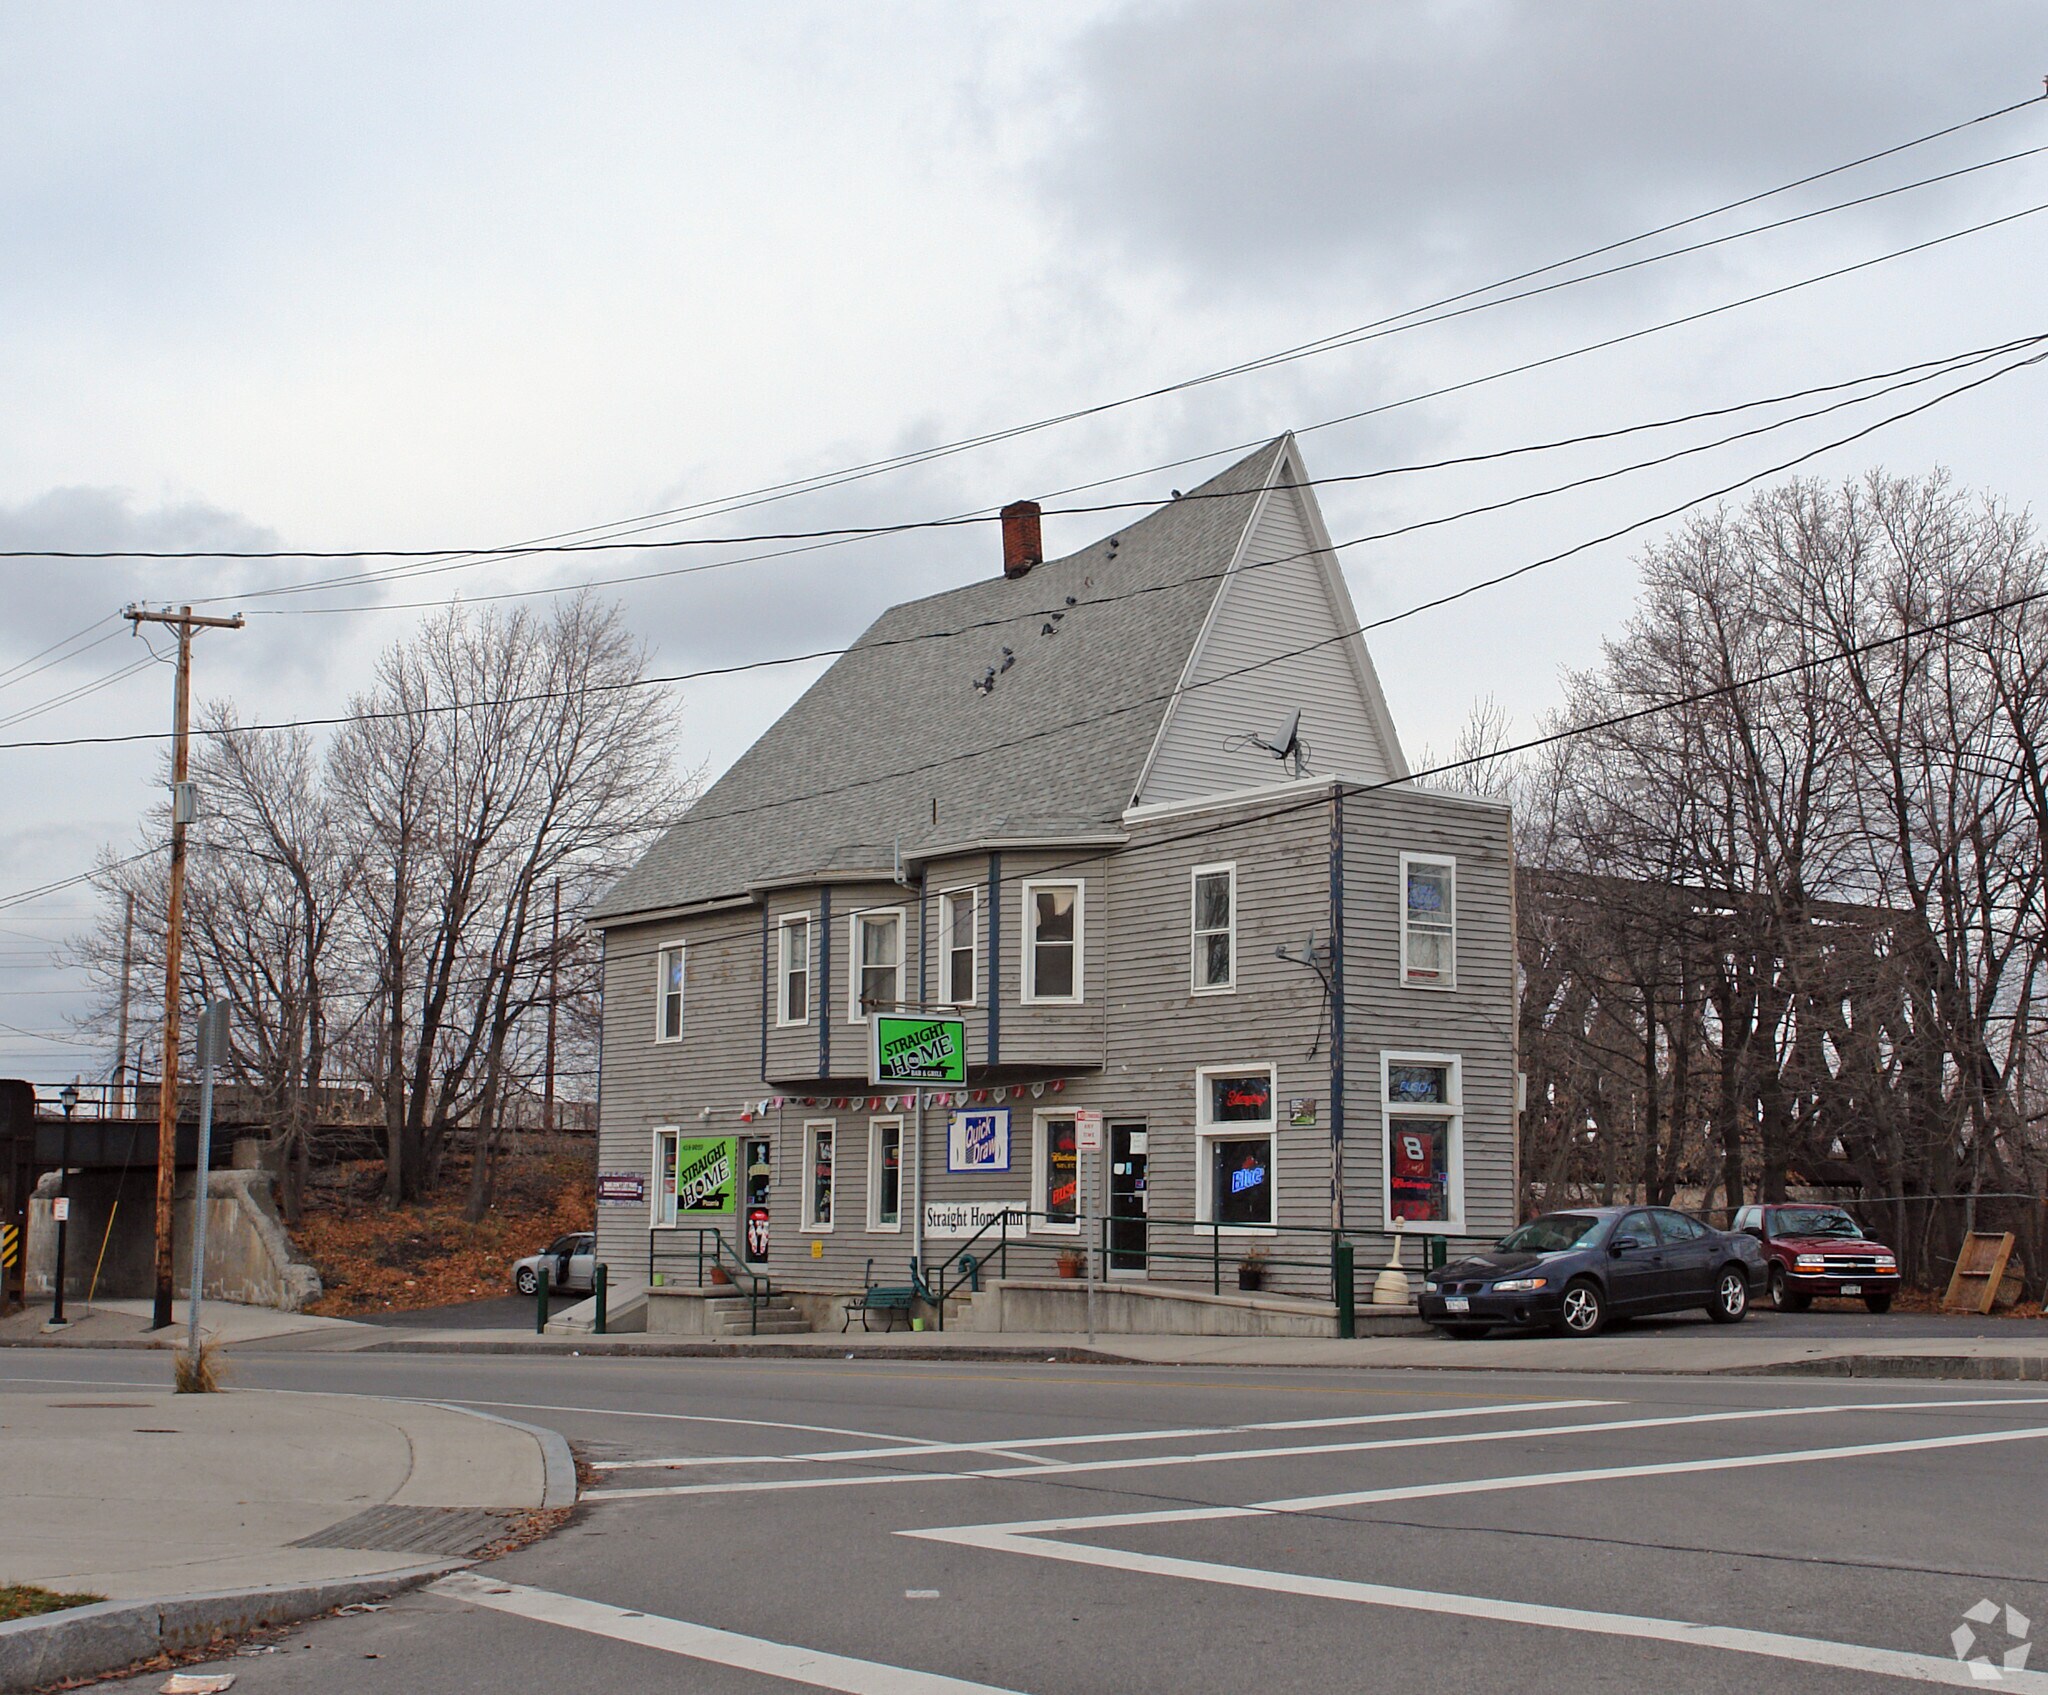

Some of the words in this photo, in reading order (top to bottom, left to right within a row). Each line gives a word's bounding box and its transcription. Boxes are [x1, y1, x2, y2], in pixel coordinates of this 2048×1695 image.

[885, 1022, 946, 1057] STRAIGHT
[889, 1034, 955, 1077] HOME
[911, 1069, 922, 1077] BAR
[928, 1070, 943, 1078] GRILL
[1400, 1081, 1432, 1093] BUSCH
[966, 1117, 992, 1148] Quick
[973, 1138, 996, 1165] Draw
[1403, 1136, 1425, 1161] 8
[682, 1141, 726, 1184] STRAIGHT
[683, 1158, 731, 1209] HOME
[1232, 1168, 1265, 1193] Blue
[927, 1206, 967, 1233] Straight
[971, 1206, 1001, 1227] Home
